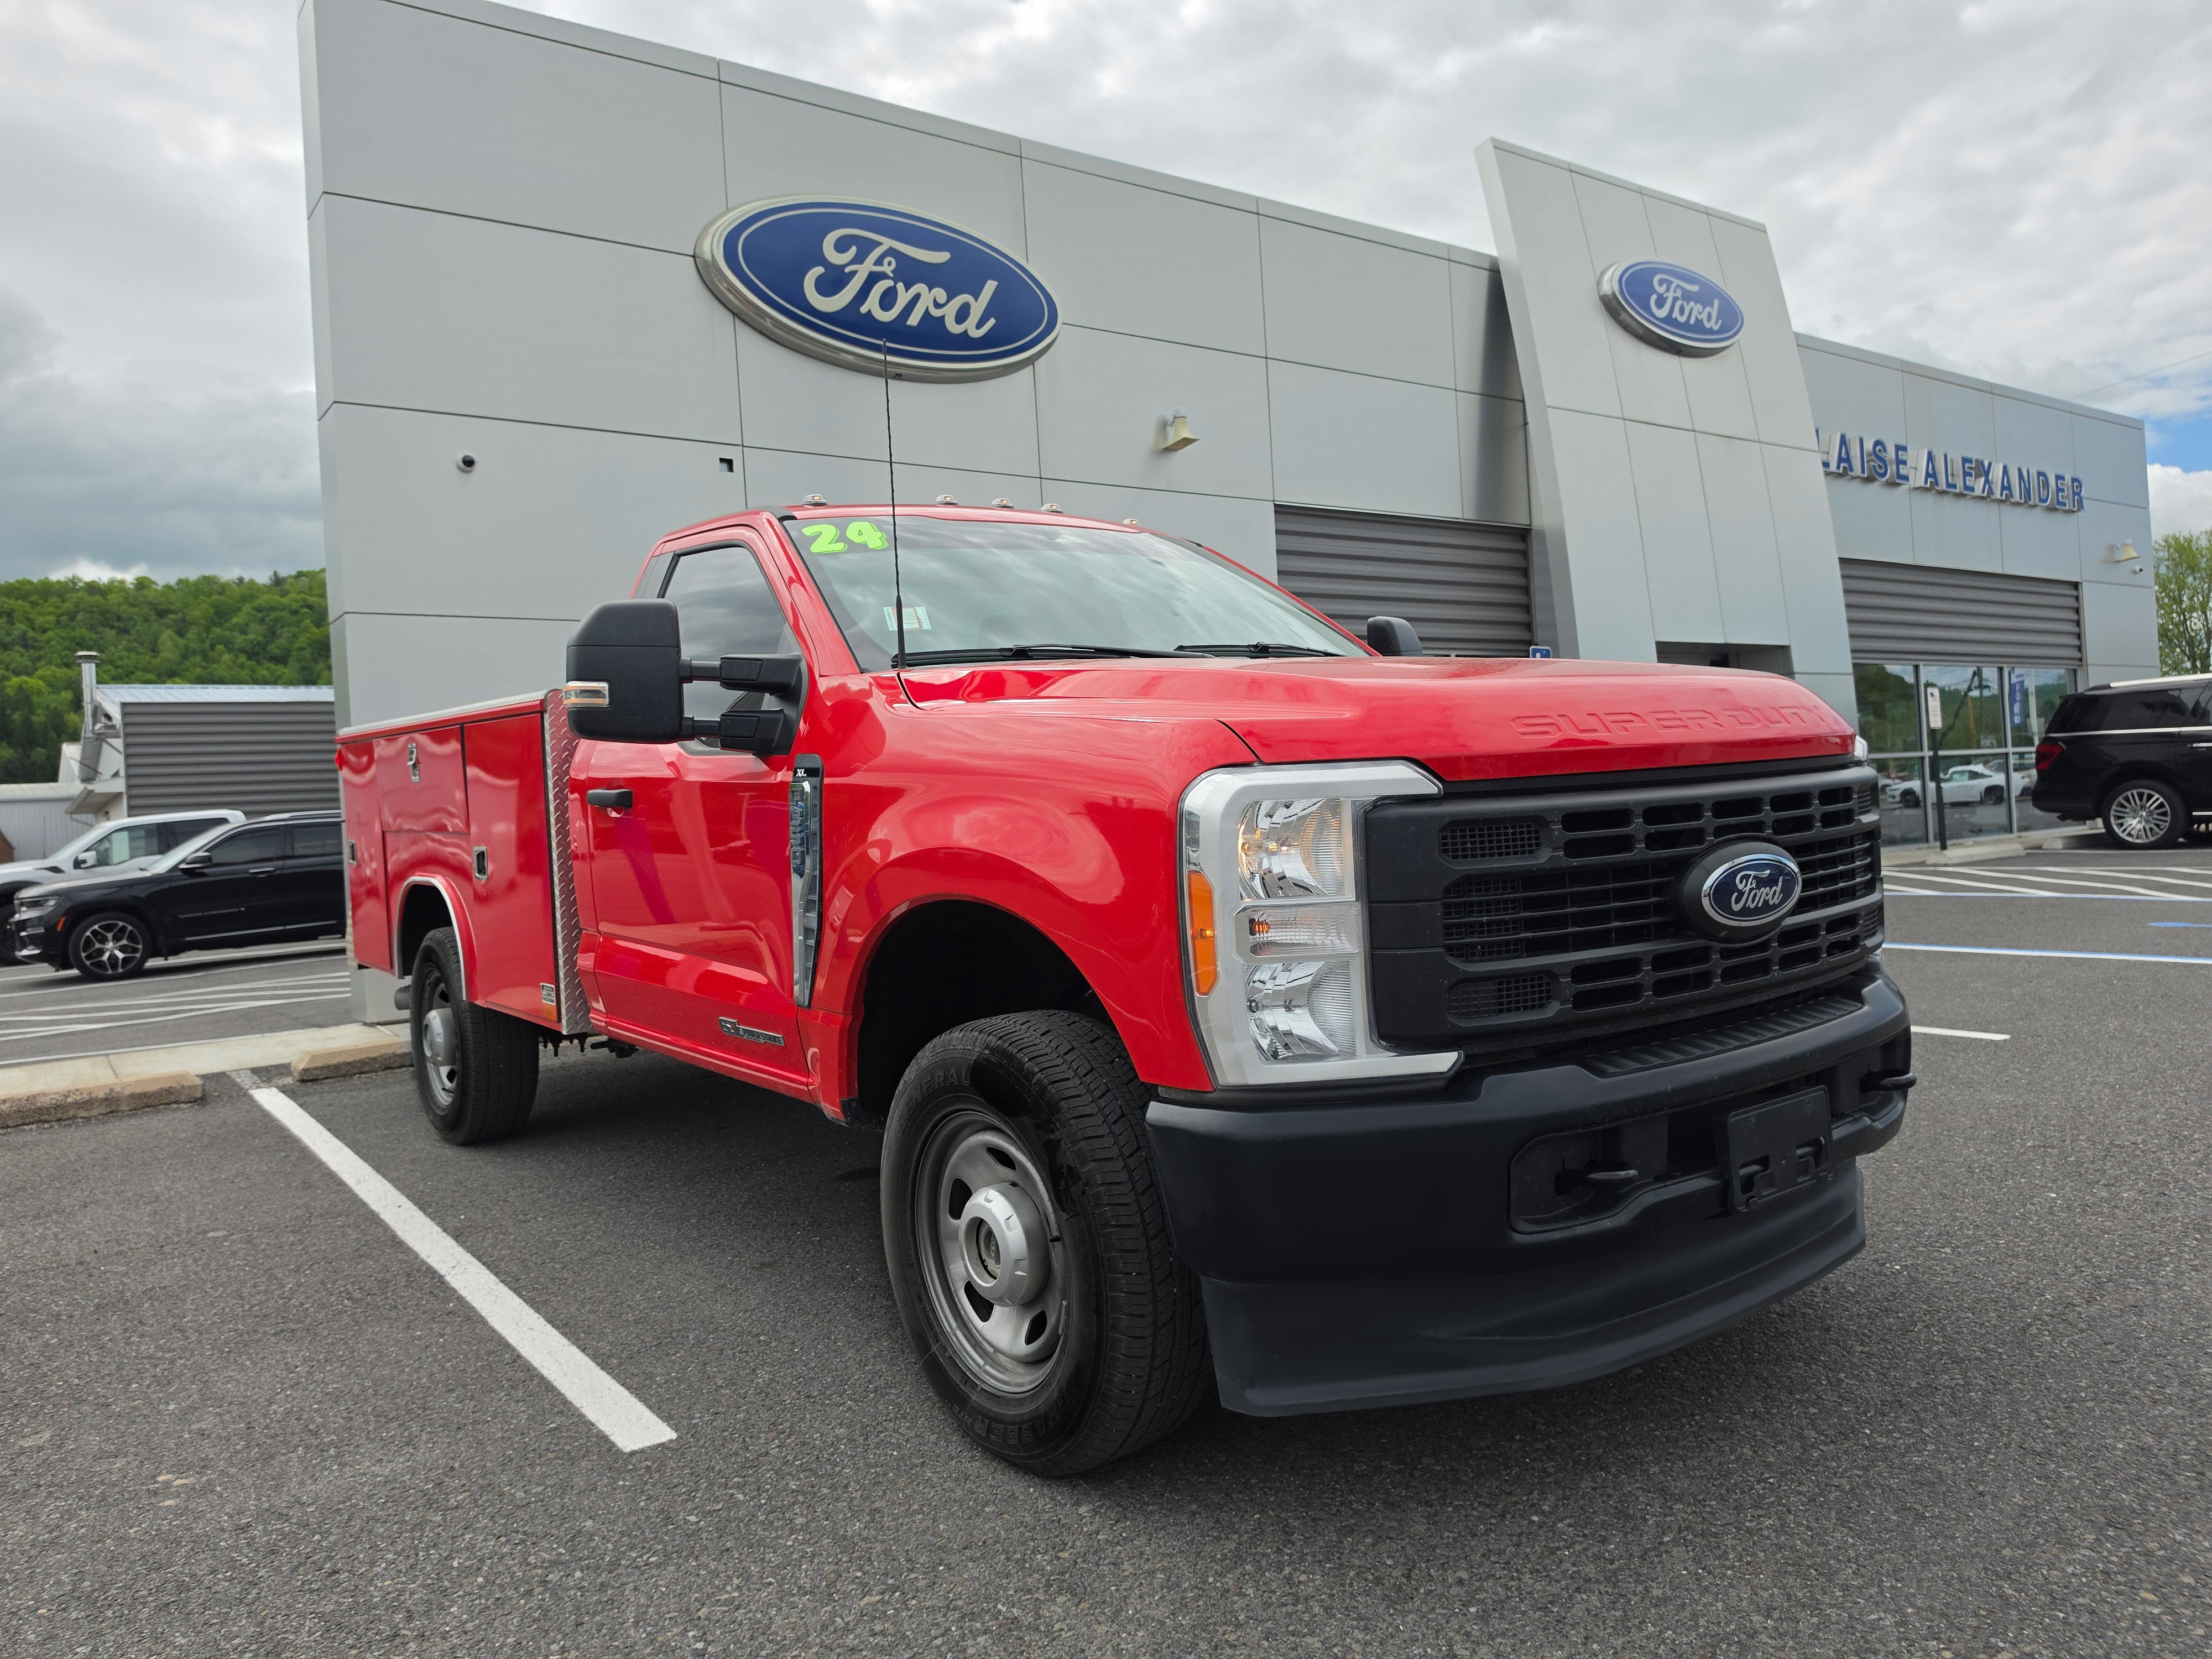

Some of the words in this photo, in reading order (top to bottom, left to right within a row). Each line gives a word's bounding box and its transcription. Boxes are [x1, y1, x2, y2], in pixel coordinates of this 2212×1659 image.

[804, 228, 999, 338] Ford
[1650, 273, 1723, 331] Ford
[1923, 448, 2084, 512] ALEXANDER
[802, 521, 889, 554] 24
[1510, 709, 1724, 739] SUPER
[795, 768, 807, 777] XL
[1730, 869, 1784, 912] Ford
[898, 1068, 973, 1136] GENERAL
[973, 1392, 1071, 1444] GRABBER
